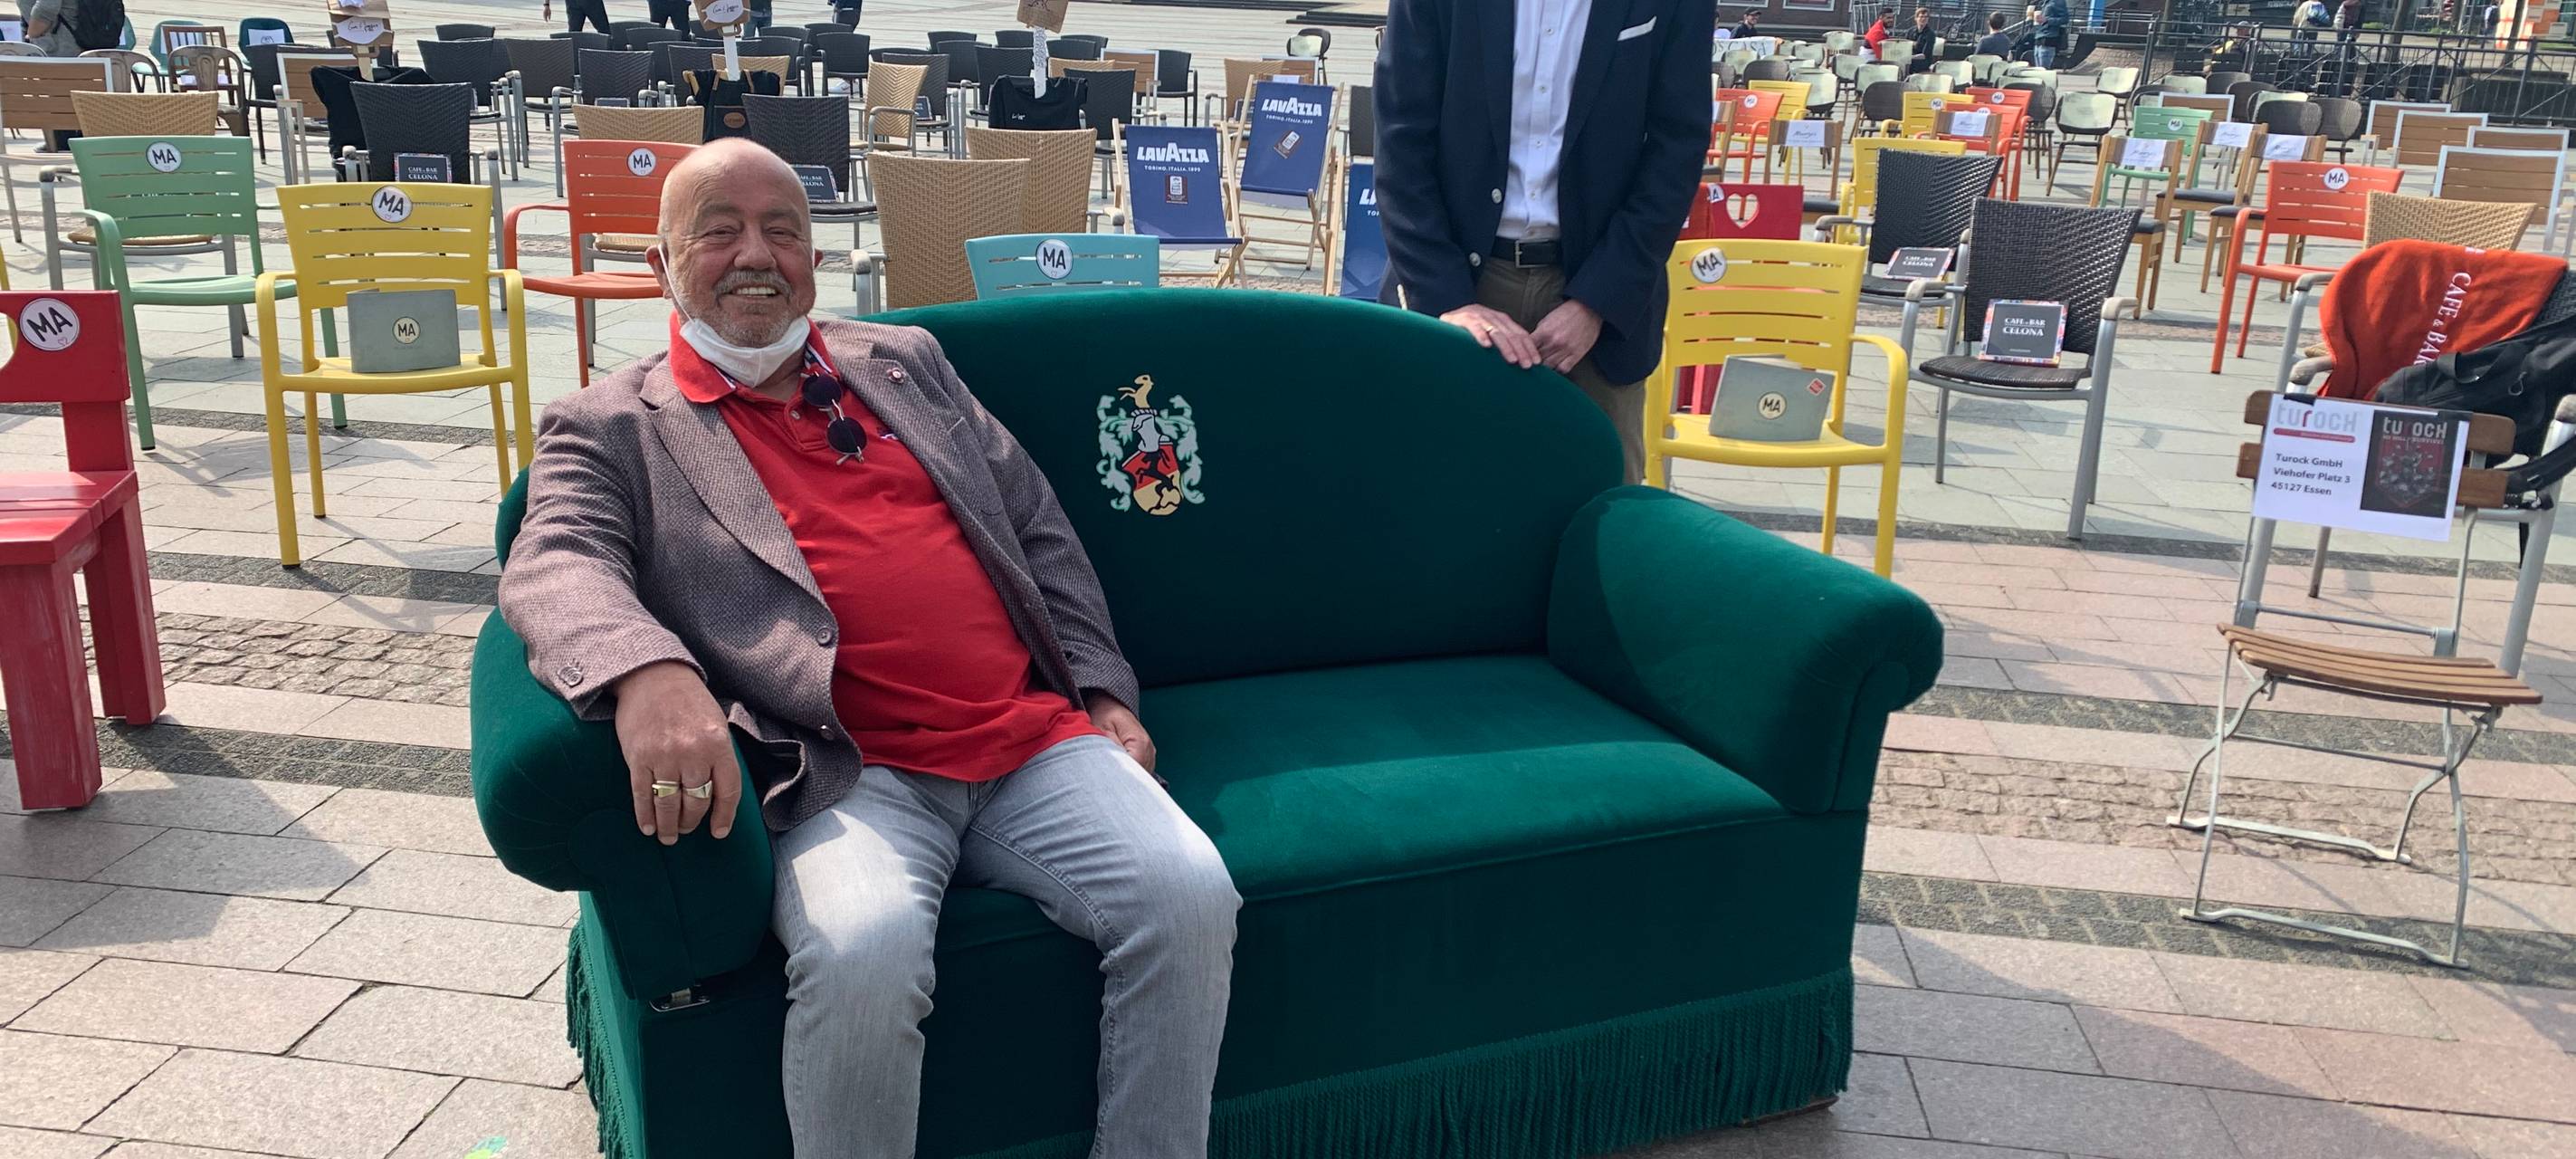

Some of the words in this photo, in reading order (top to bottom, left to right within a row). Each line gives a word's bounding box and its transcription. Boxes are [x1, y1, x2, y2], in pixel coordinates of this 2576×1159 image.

[1262, 96, 1321, 117] LAVAZZA
[151, 148, 178, 165] MA
[1137, 142, 1209, 163] LAVAZZA
[633, 153, 653, 169] MA
[407, 173, 439, 181] CELONA
[2328, 172, 2345, 184] MA
[377, 191, 405, 216] MA
[1043, 246, 1066, 270] MA
[1695, 252, 1723, 277] MA
[2437, 272, 2472, 319] CAFE
[25, 306, 73, 342] MA
[397, 322, 416, 338] MA
[2004, 317, 2024, 326] CAFE
[2029, 319, 2046, 327] BAR
[2432, 318, 2445, 327] &
[2003, 326, 2045, 337] CELONA
[1761, 398, 1781, 414] MA
[2275, 453, 2310, 465] Turock
[2311, 457, 2343, 468] GmbH
[2274, 467, 2315, 480] Viehofer
[2317, 472, 2342, 483] Platz
[2344, 475, 2351, 484] 3
[2271, 482, 2302, 493] 45127
[2303, 484, 2333, 495] Essen
